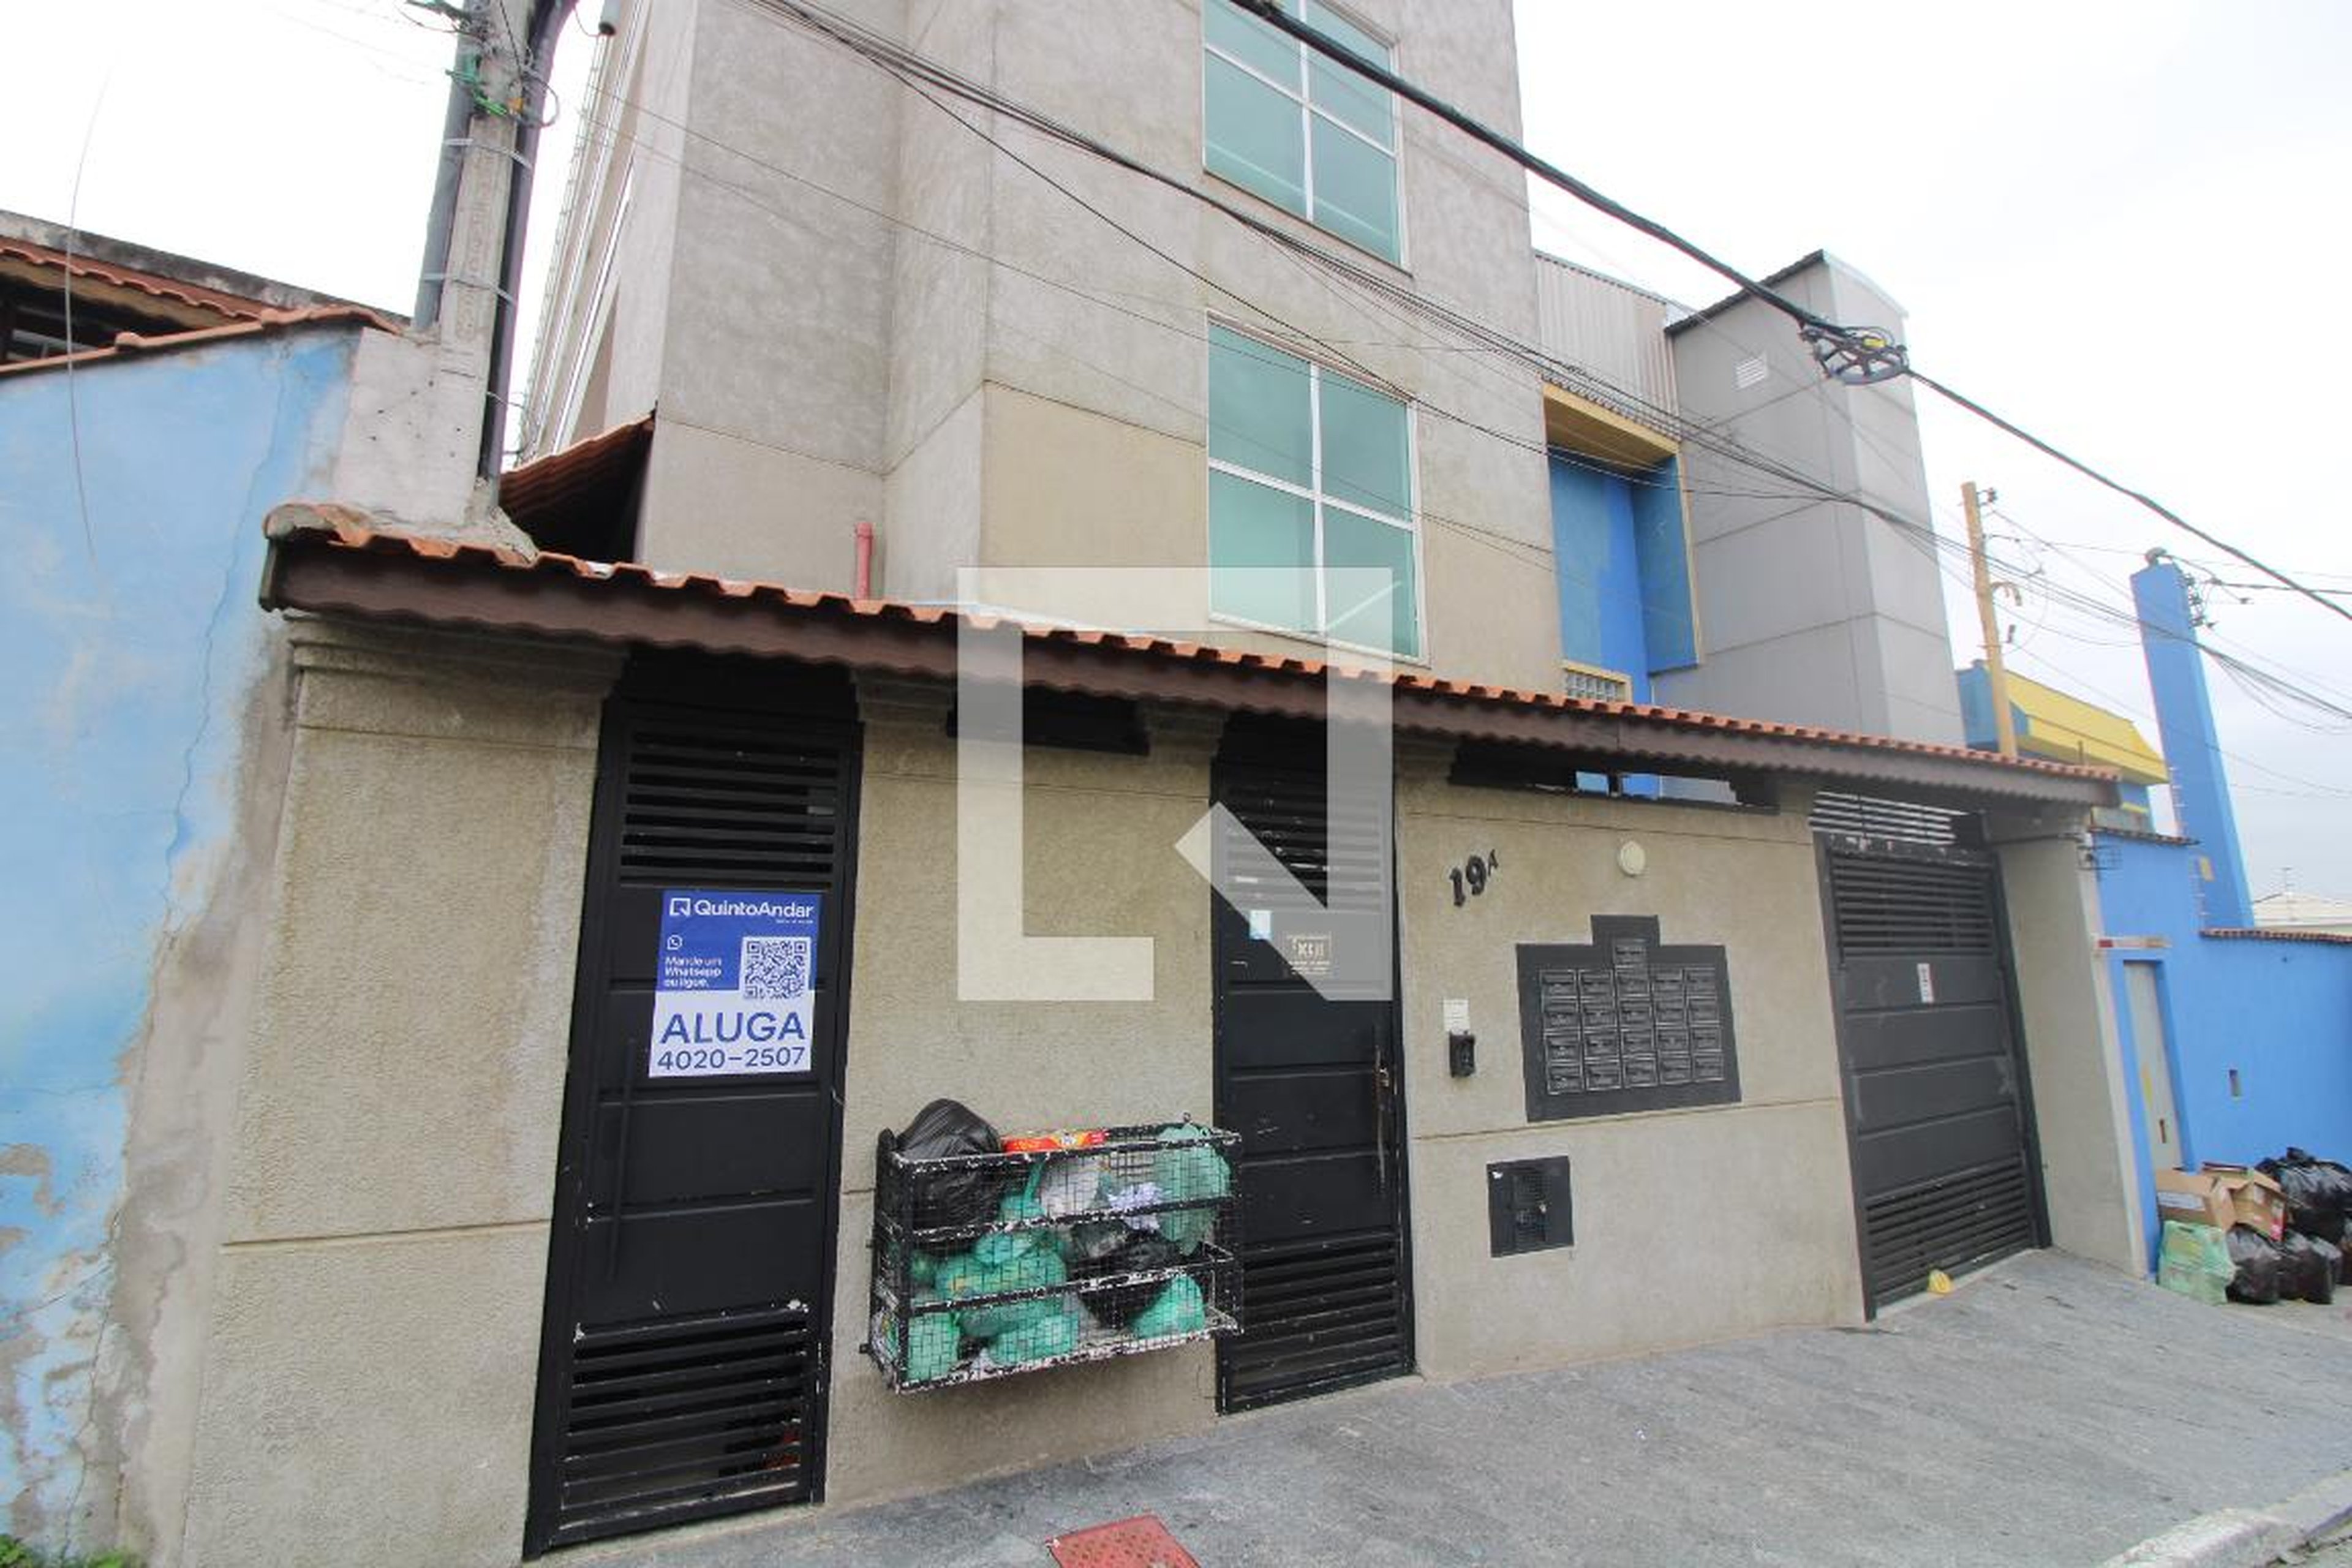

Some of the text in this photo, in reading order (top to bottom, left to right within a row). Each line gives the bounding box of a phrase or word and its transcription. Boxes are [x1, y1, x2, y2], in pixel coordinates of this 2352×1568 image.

[695, 899, 814, 918] QuintoAndar
[660, 1012, 805, 1044] ALUGA
[657, 1047, 805, 1070] 4020-2507
